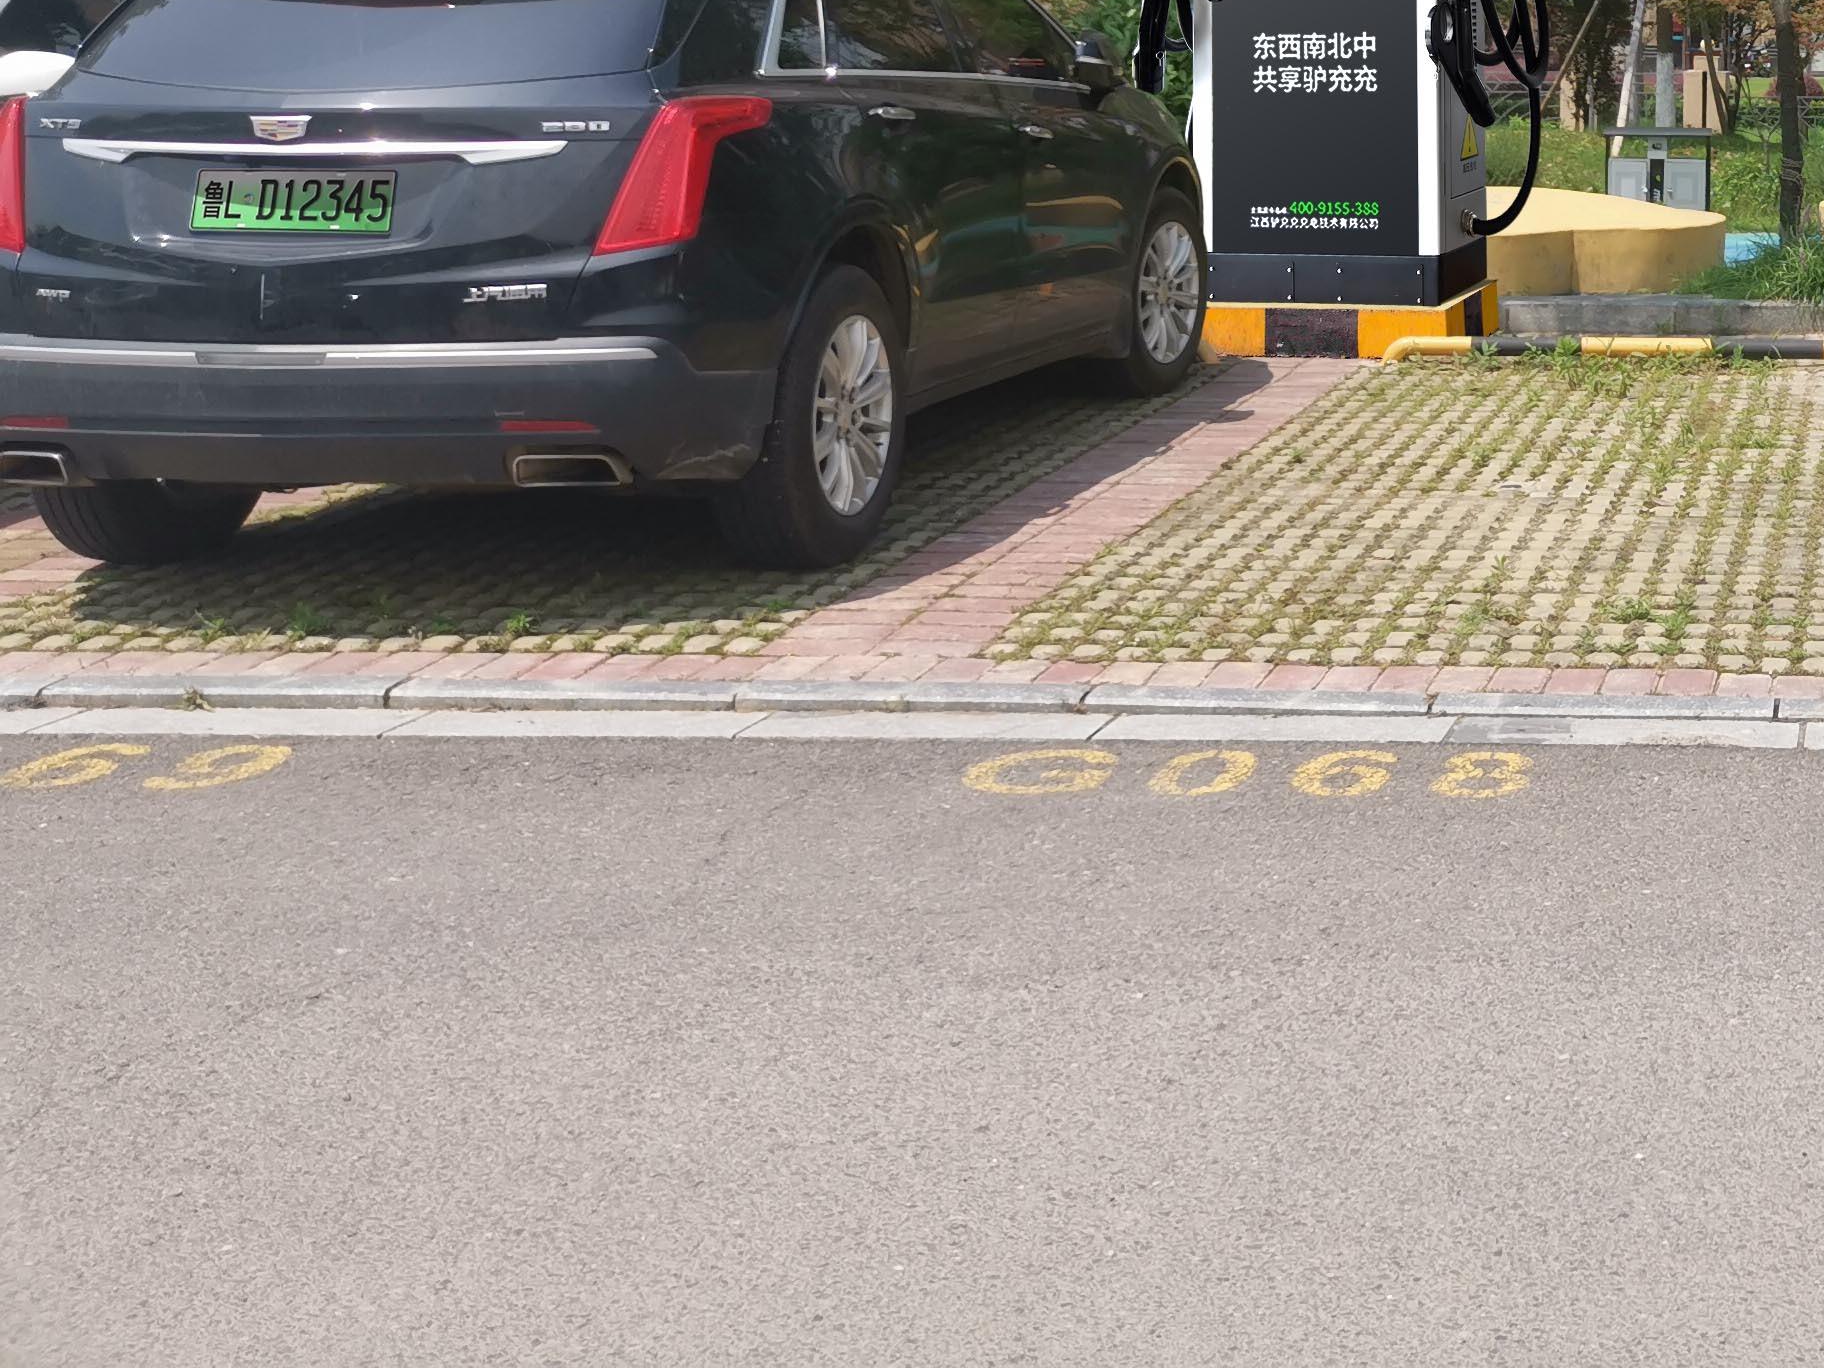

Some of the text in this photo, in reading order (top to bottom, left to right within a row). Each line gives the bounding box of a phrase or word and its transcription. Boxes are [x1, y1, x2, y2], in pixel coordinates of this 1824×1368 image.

[1252, 31, 1377, 60] 东西南北中
[1252, 65, 1378, 93] 共享驴充充
[961, 748, 1535, 799] G068
